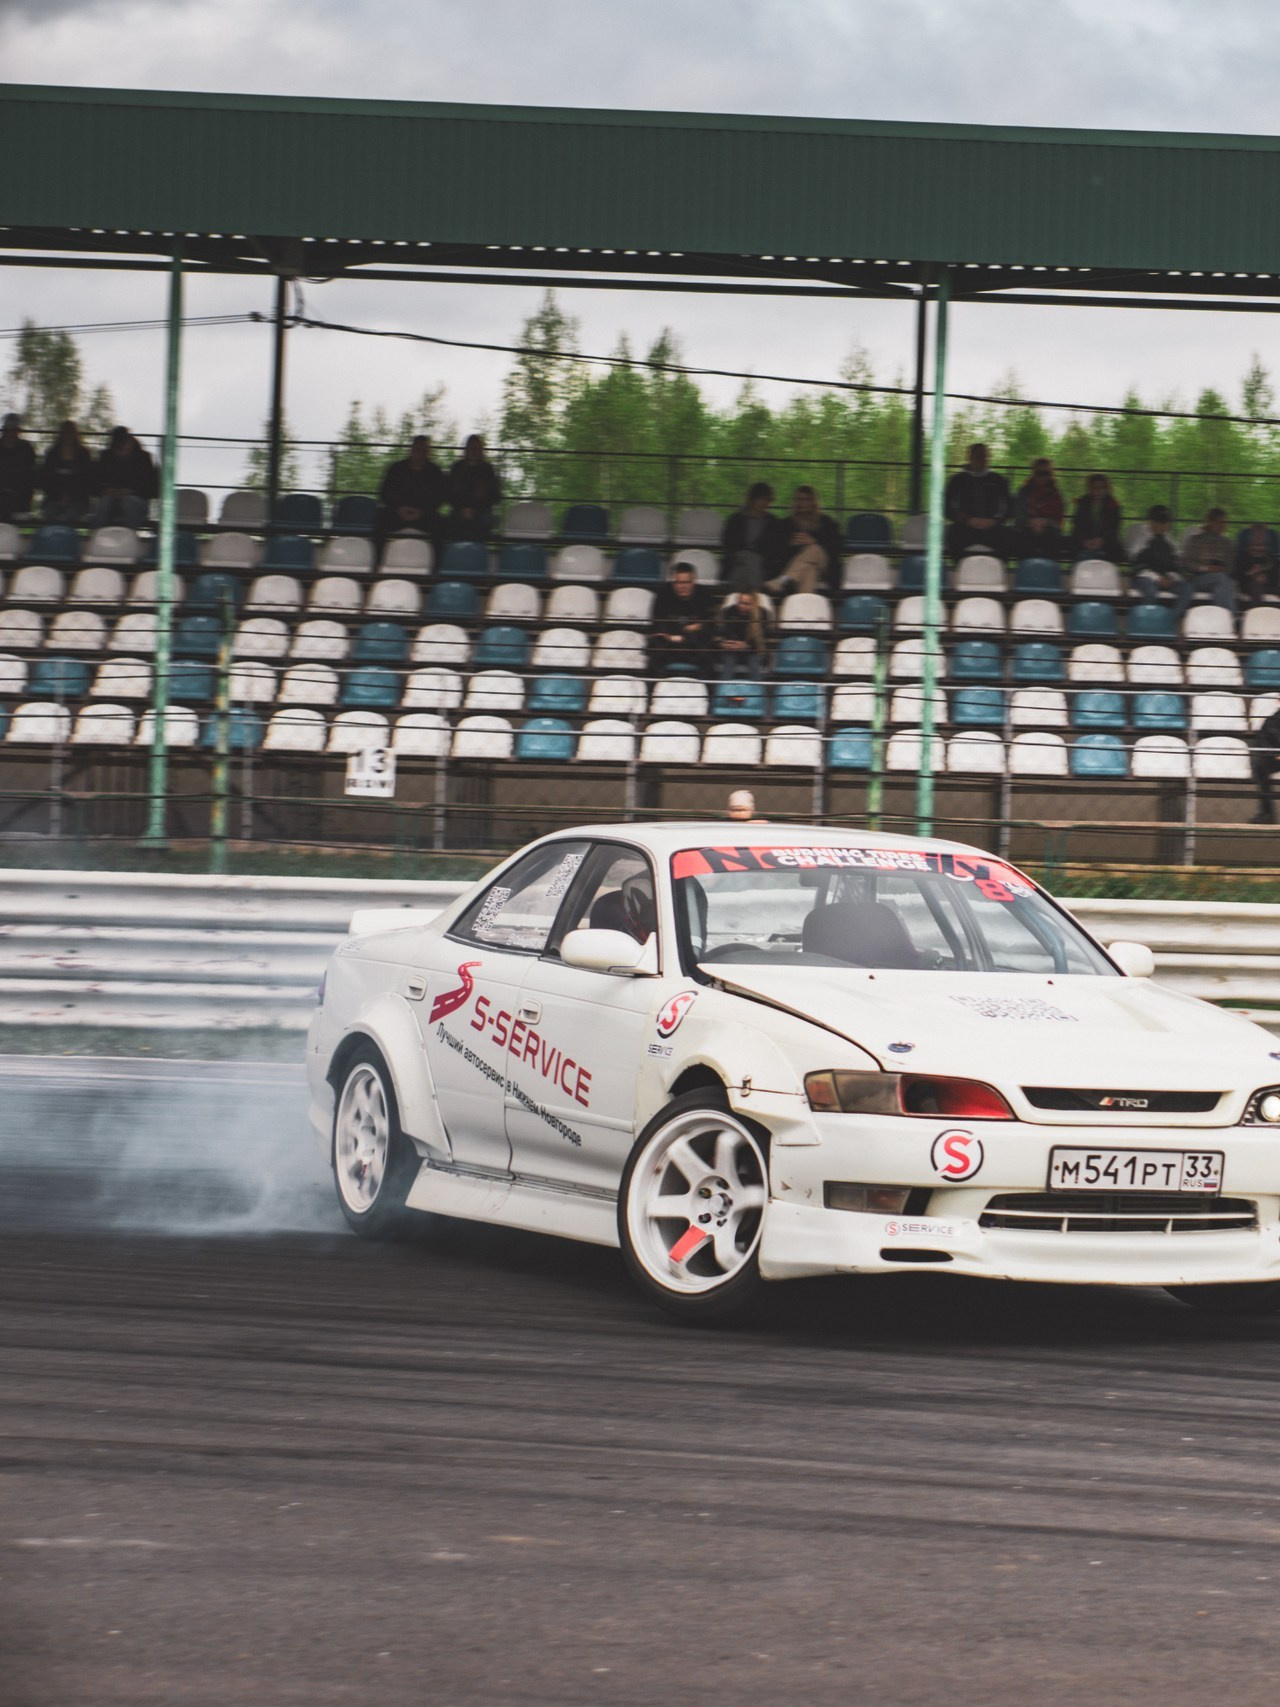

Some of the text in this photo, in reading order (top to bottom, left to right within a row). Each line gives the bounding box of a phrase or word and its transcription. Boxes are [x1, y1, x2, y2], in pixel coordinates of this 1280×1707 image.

[350, 748, 388, 774] 13
[770, 848, 864, 858] BURNING
[777, 855, 933, 871] CHALLENGE
[975, 879, 1016, 902] 8
[470, 995, 592, 1108] S-SERVICE
[436, 1021, 464, 1055] Лучший
[464, 1047, 504, 1088] автосервис
[540, 1105, 582, 1147] Новгороде
[1113, 1097, 1149, 1108] TRD
[1186, 1155, 1213, 1178] 33
[1183, 1179, 1203, 1188] RUS
[902, 1223, 954, 1235] SERVICE
